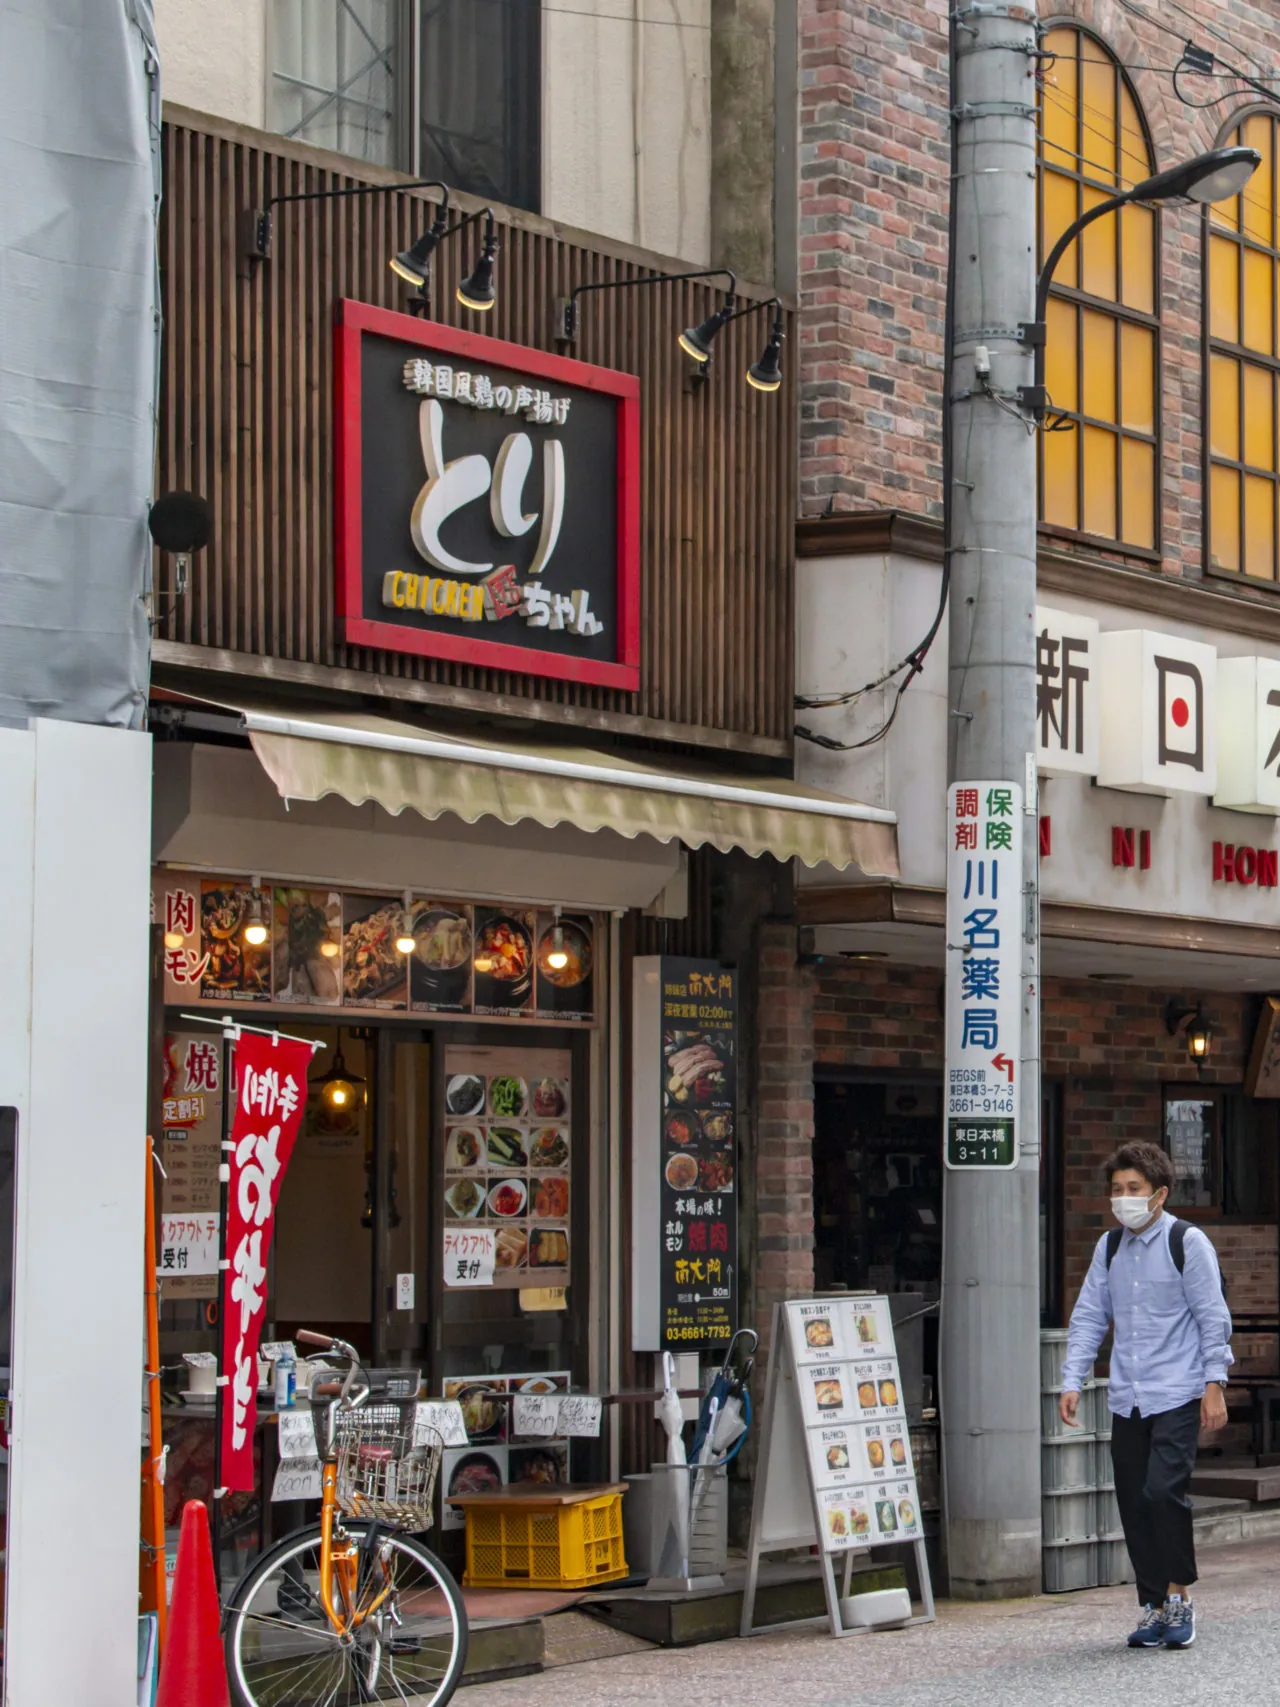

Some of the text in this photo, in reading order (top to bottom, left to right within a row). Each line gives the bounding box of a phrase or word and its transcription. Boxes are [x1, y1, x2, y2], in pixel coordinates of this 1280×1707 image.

[403, 358, 571, 424] 韓国風鶏の唐揚げ
[411, 399, 564, 573] とり
[386, 570, 484, 621] CHICKEN
[519, 582, 604, 635] ちゃん
[955, 789, 979, 850] 調剤
[986, 788, 1013, 851] 保険
[1112, 826, 1151, 870] NI
[1212, 841, 1278, 887] HON
[961, 859, 1000, 1049] 川名薬局
[949, 1099, 1014, 1113] 3661-9146
[955, 1128, 1006, 1142] 東日本橋
[959, 1147, 999, 1160] 3-11
[163, 1247, 188, 1268] 受付
[457, 1259, 481, 1279] 受付
